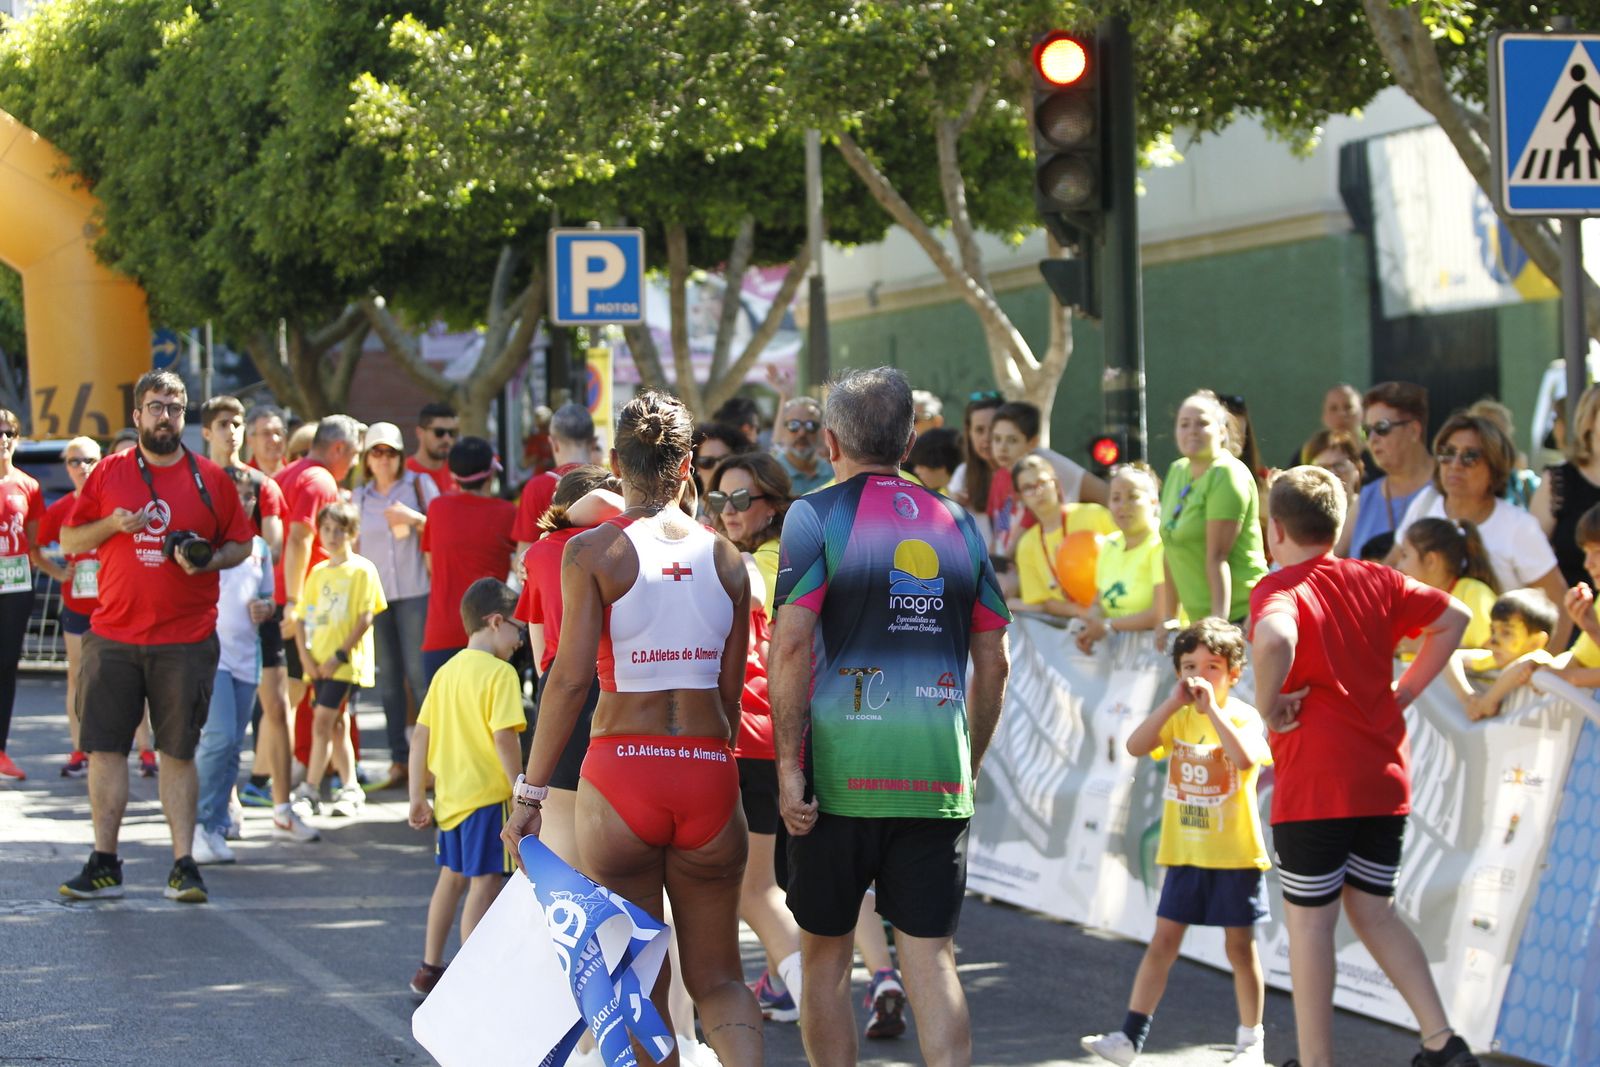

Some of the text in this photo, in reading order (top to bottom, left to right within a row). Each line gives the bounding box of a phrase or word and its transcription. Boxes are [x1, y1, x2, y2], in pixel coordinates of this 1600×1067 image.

[571, 240, 626, 314] P
[595, 302, 638, 314] MOTOS
[889, 595, 944, 614] inagro
[895, 614, 929, 624] Especialistas
[887, 623, 919, 633] Agricultura
[631, 649, 680, 664] C.D.Atletas
[682, 648, 692, 660] de
[616, 745, 676, 757] C.D.Atletas
[678, 747, 690, 758] de
[1181, 762, 1208, 785] 99
[848, 778, 911, 791] ESPARTANOS
[912, 780, 928, 792] DEL
